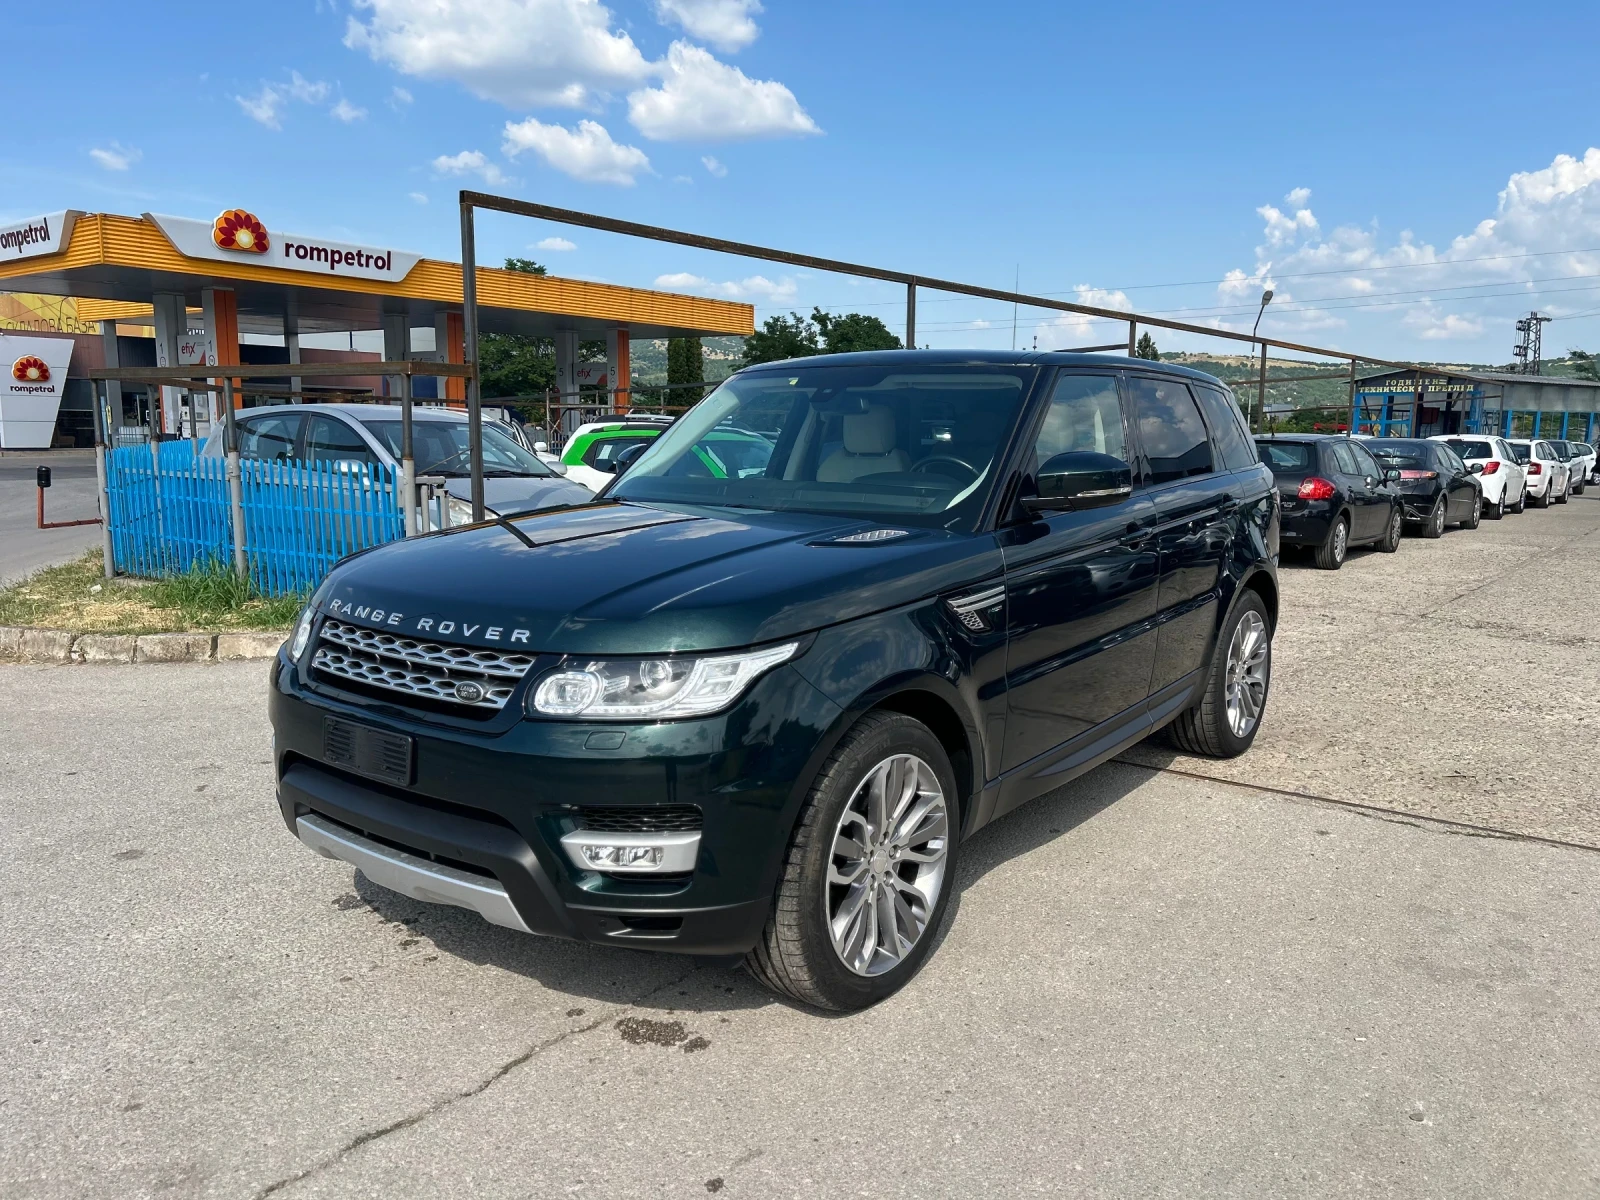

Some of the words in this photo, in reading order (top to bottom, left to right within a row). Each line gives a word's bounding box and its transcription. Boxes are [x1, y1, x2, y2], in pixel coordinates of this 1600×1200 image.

[0, 217, 50, 253] ompetrol
[284, 242, 392, 271] rompetrol
[181, 342, 196, 357] efix
[610, 366, 616, 376] 5
[10, 385, 55, 394] rompetrol
[330, 598, 403, 626] RANGE
[416, 617, 531, 643] ROVER
